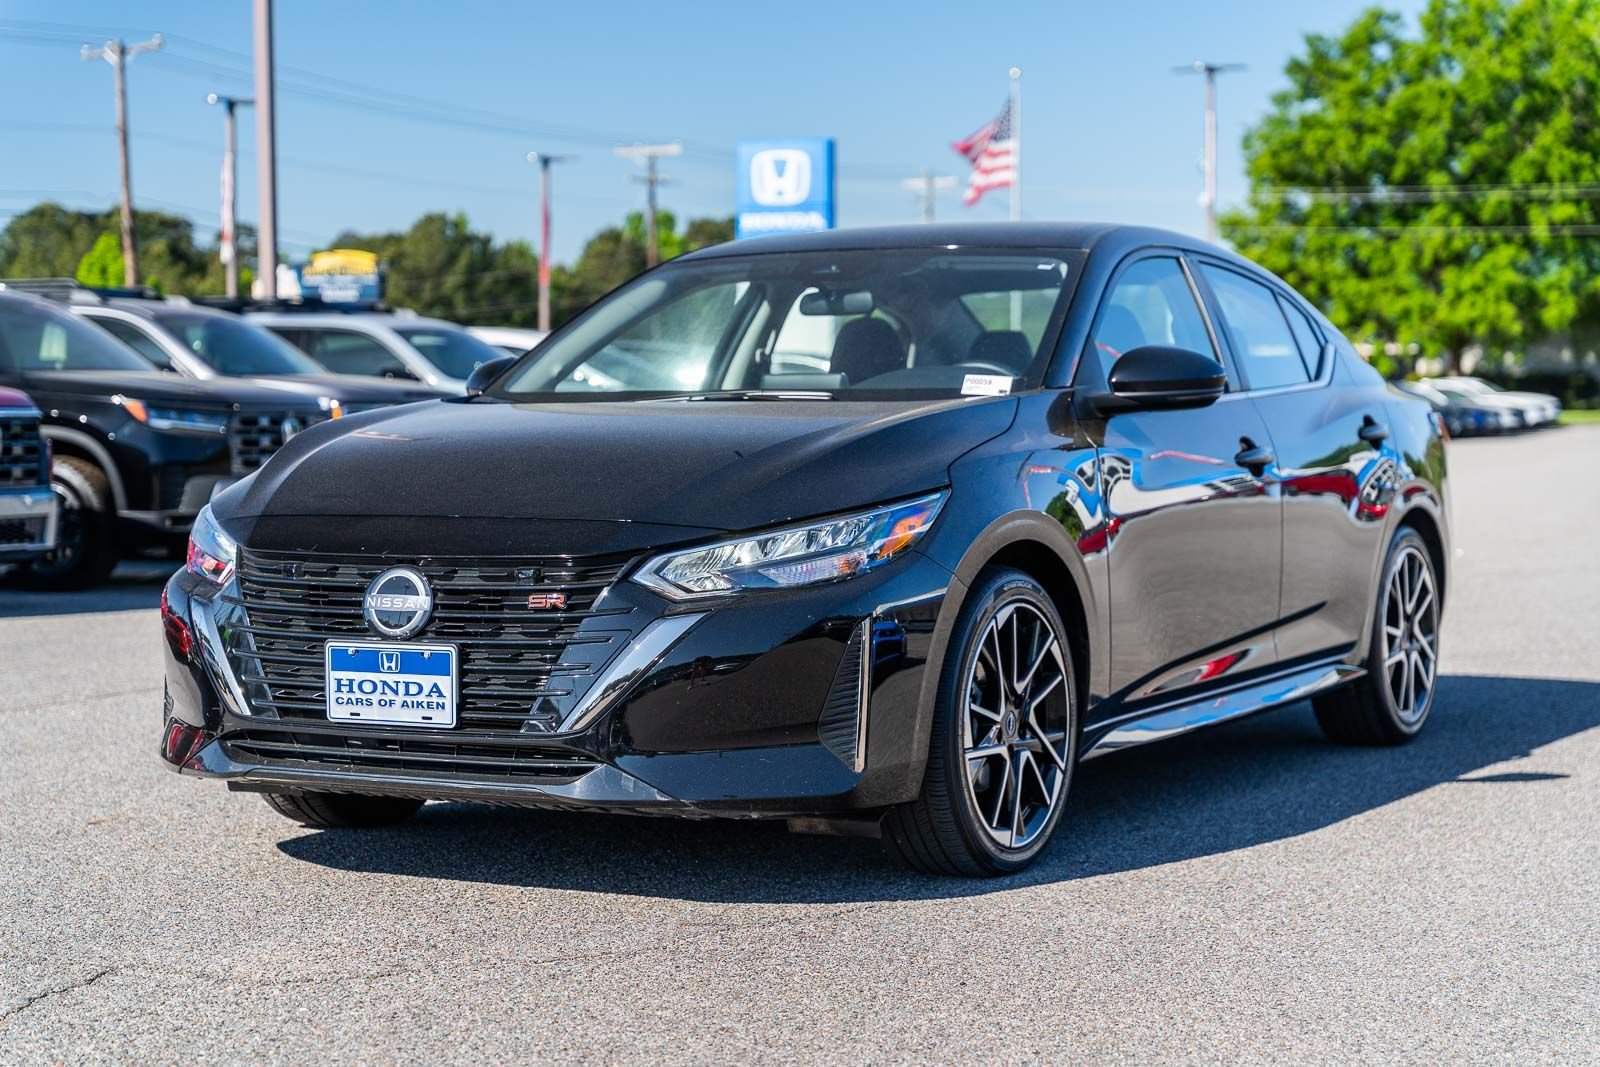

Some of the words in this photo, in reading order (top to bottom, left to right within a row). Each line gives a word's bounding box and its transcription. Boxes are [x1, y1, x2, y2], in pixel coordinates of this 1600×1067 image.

[366, 597, 429, 609] NISSAN
[528, 593, 567, 609] SR
[334, 678, 446, 697] HONDA
[335, 696, 374, 707] CARS
[378, 698, 396, 708] OF
[401, 699, 446, 710] AIKEN
